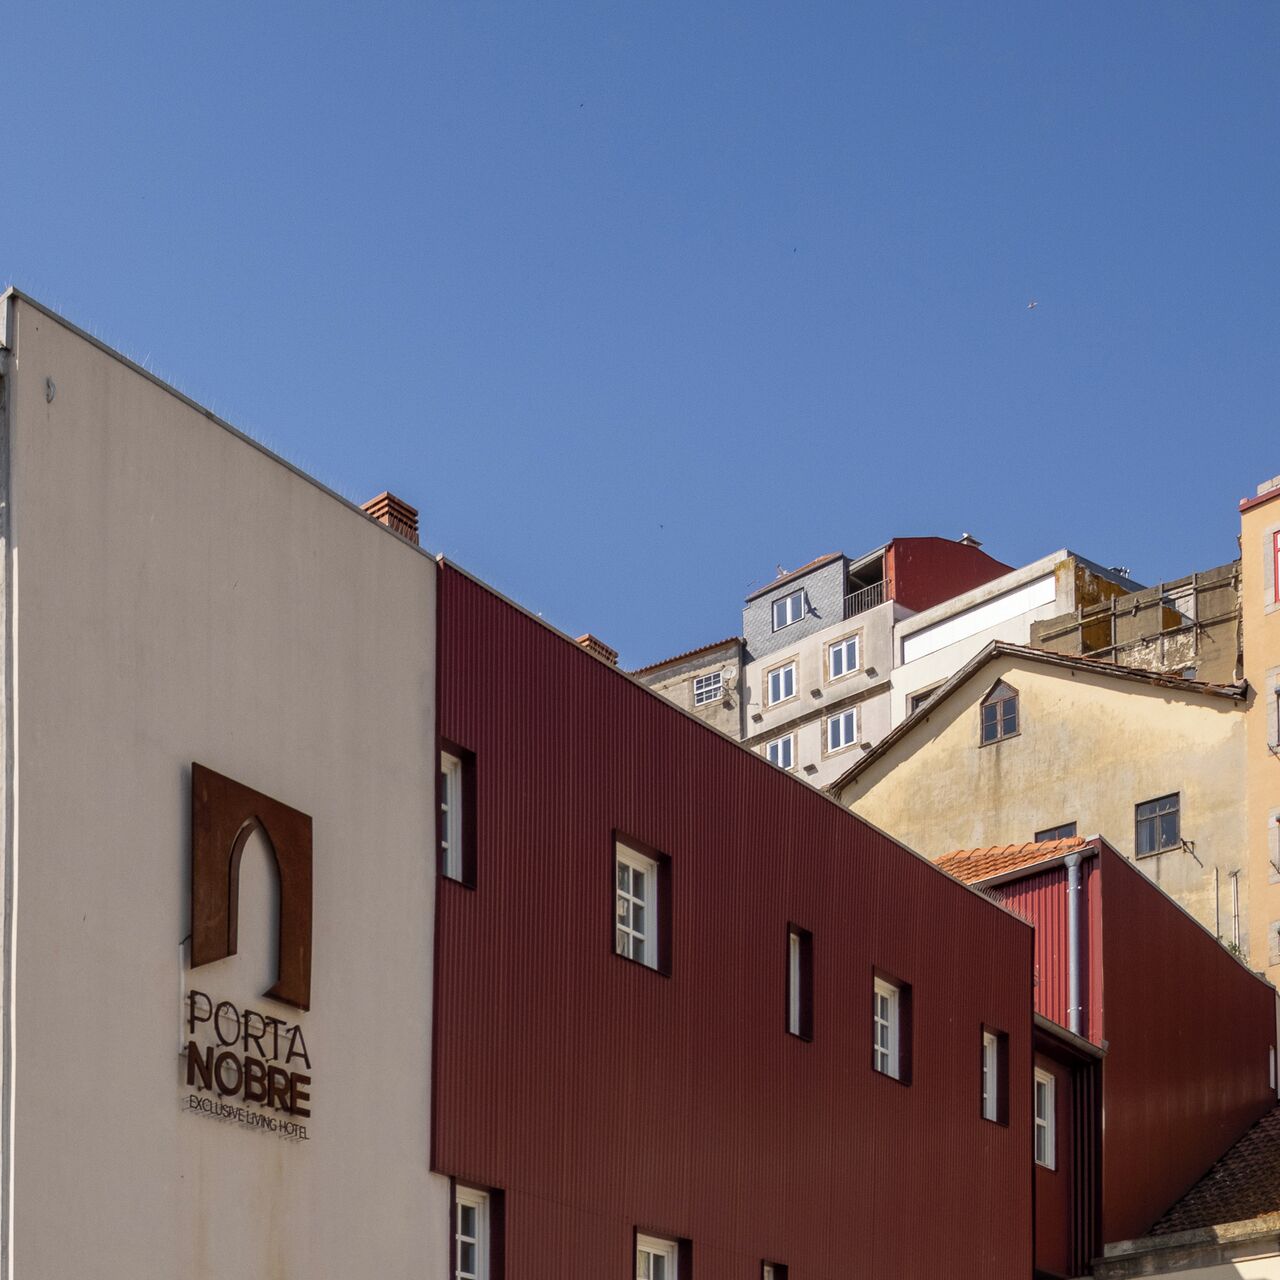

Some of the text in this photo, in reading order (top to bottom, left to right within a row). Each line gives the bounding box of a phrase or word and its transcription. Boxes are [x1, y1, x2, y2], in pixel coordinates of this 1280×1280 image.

[190, 990, 311, 1069] PORTA
[187, 1041, 311, 1118] NOBRE
[190, 1094, 310, 1140] EXCLUSIVE LIVING HOTEL
